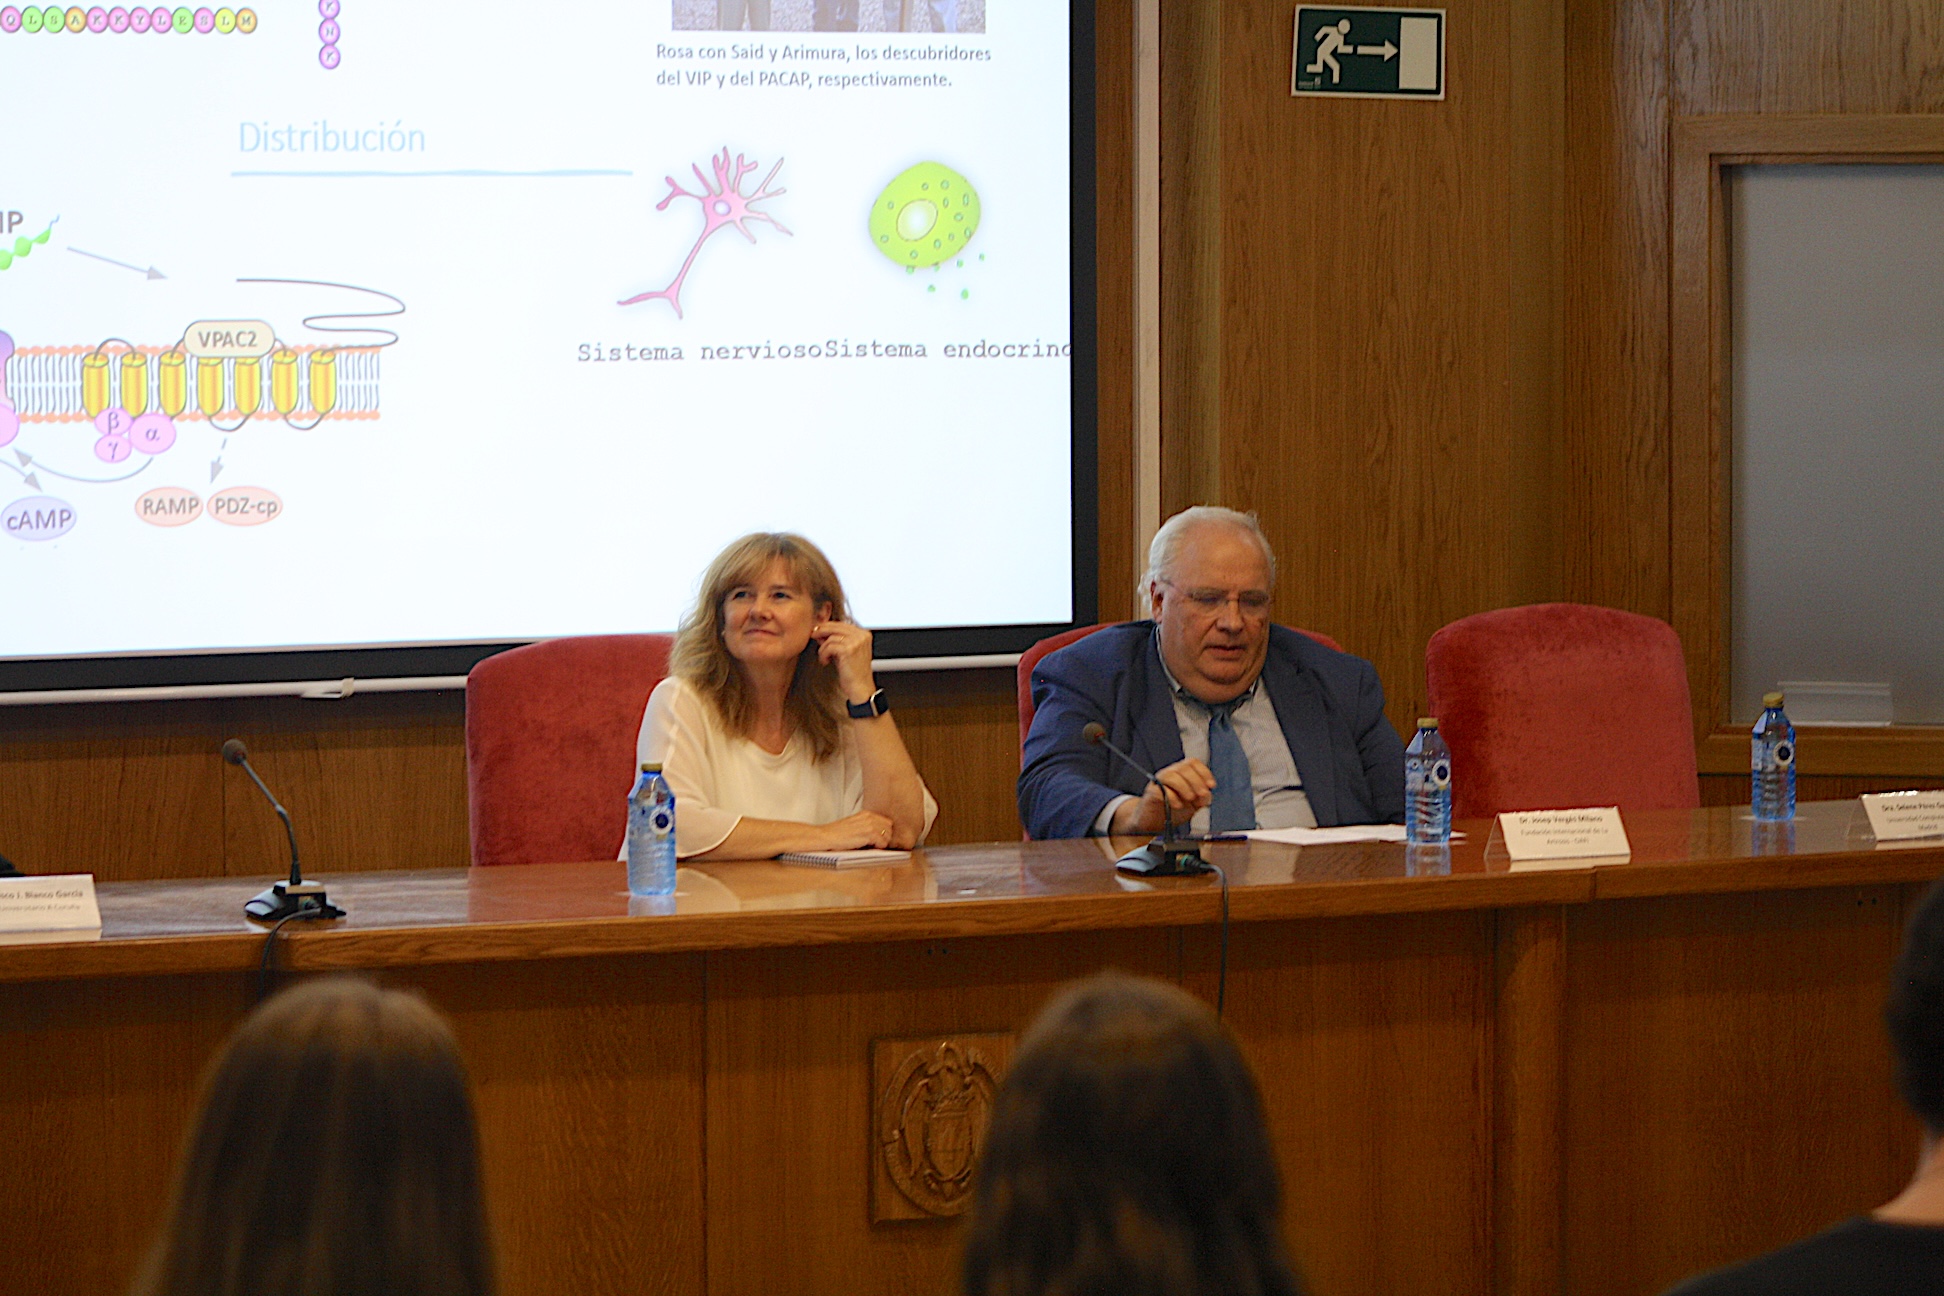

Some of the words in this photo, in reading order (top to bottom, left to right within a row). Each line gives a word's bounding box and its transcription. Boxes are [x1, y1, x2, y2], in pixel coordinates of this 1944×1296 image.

[656, 43, 694, 60] Rosa
[698, 48, 727, 60] con
[731, 44, 764, 60] Said
[768, 49, 778, 64] y
[782, 44, 851, 64] Arimura,
[856, 45, 879, 61] los
[882, 45, 992, 62] descubridores
[656, 70, 681, 86] del
[685, 71, 712, 87] VIP
[716, 74, 726, 90] y
[730, 70, 754, 87] del
[759, 71, 813, 90] PACAP,
[818, 71, 953, 91] respectivamente.
[239, 119, 426, 153] Distribución
[198, 330, 258, 348] VPAC2
[577, 343, 685, 363] Sistema
[143, 497, 200, 516] RAMP
[214, 497, 278, 518] PDZ-cp
[6, 509, 73, 531] cAMP
